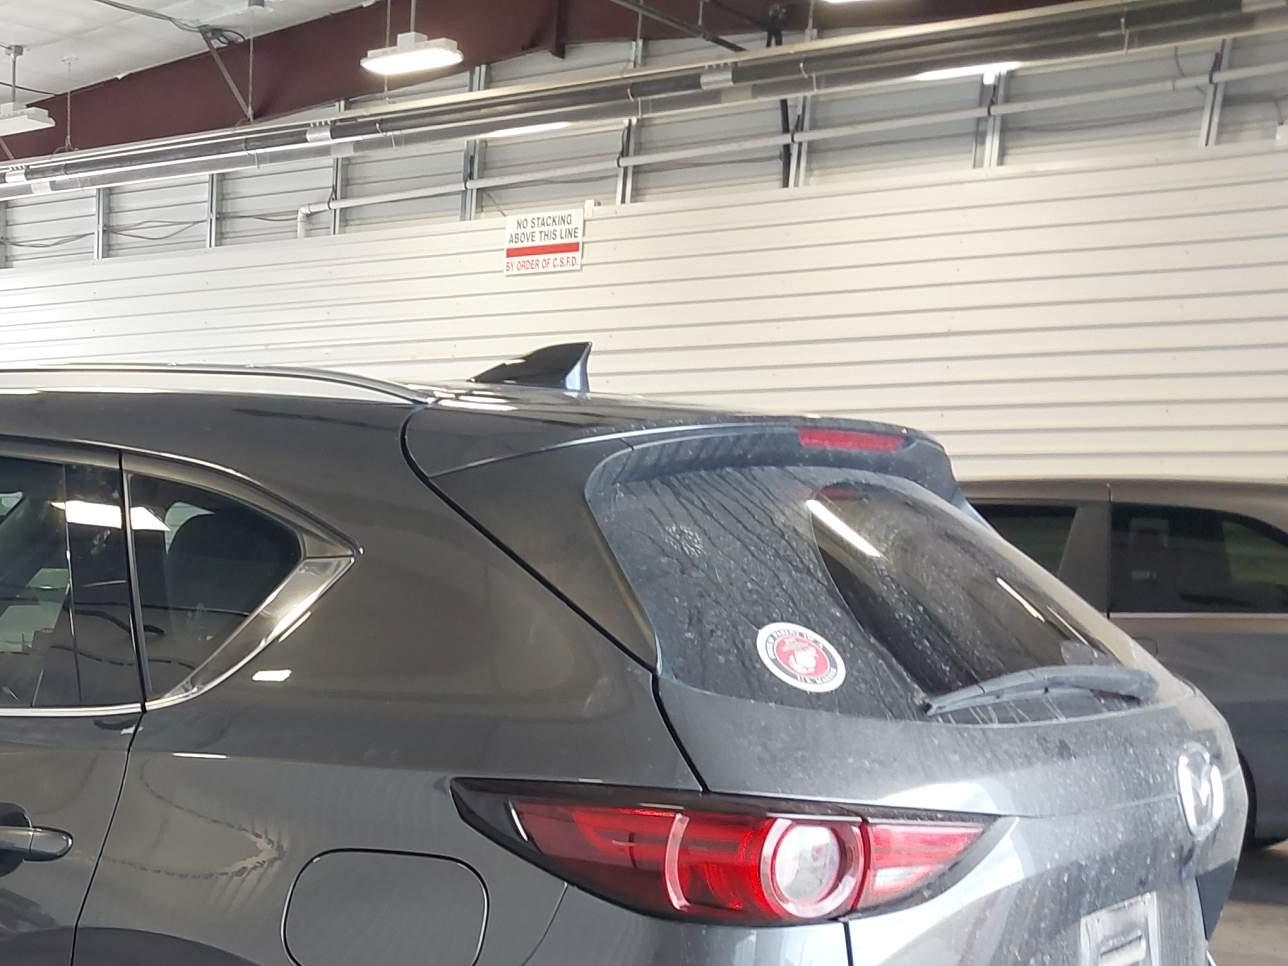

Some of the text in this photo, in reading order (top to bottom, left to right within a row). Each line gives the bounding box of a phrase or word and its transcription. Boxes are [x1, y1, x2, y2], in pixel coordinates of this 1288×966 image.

[516, 213, 572, 230] NO STACKING
[508, 227, 579, 244] ABOVE THIS LINE
[505, 256, 579, 272] BY ORDER OF C.S.F.D.
